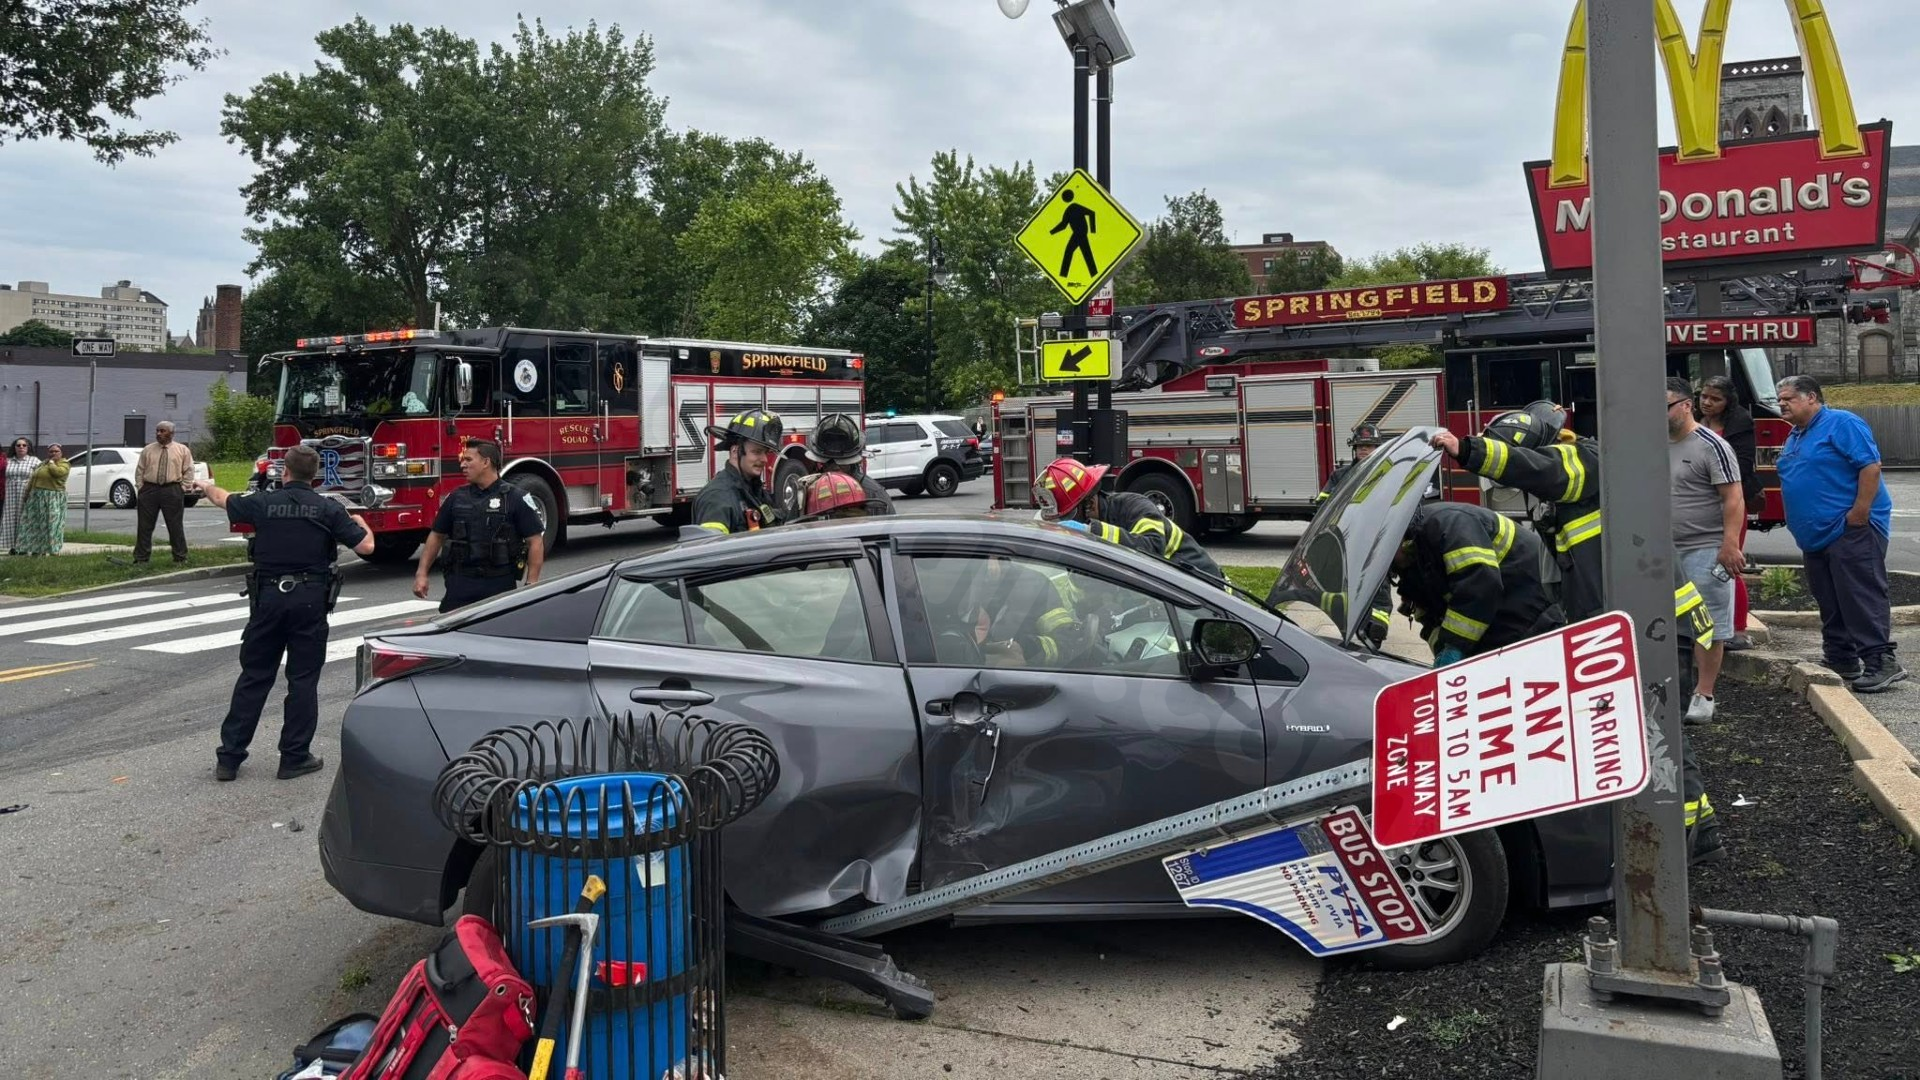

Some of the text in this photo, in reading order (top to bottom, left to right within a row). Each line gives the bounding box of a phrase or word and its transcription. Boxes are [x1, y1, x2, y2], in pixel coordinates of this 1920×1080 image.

[1555, 172, 1872, 232] MDonald's
[1661, 222, 1795, 251] staurant
[1243, 280, 1497, 321] SPRINGFIELD
[82, 342, 112, 353] ONE WAY
[1665, 322, 1799, 343] IVE-THRU
[742, 353, 827, 373] SPRINGFIELD
[314, 426, 360, 438] SPRINGFIELD
[559, 423, 590, 435] RESCUE
[562, 436, 588, 444] SQUAD
[267, 504, 319, 518] POLICE
[1570, 622, 1626, 683] NO
[1445, 675, 1471, 819] 9PM TO 5AM
[1477, 677, 1516, 793] TIME
[1523, 681, 1566, 762] ANY
[1589, 691, 1622, 791] PARKING
[1387, 734, 1408, 790] ZONE
[1413, 690, 1436, 815] TOW AWAY
[1168, 860, 1191, 886] 1267
[1180, 857, 1200, 884] Stop ID
[1280, 866, 1319, 925] NO PARKING
[1289, 863, 1321, 909] pvta.com
[1301, 862, 1344, 929] 413 781 PVTA
[1328, 817, 1416, 933] BUS STOP
[1317, 866, 1374, 937] PVTA
